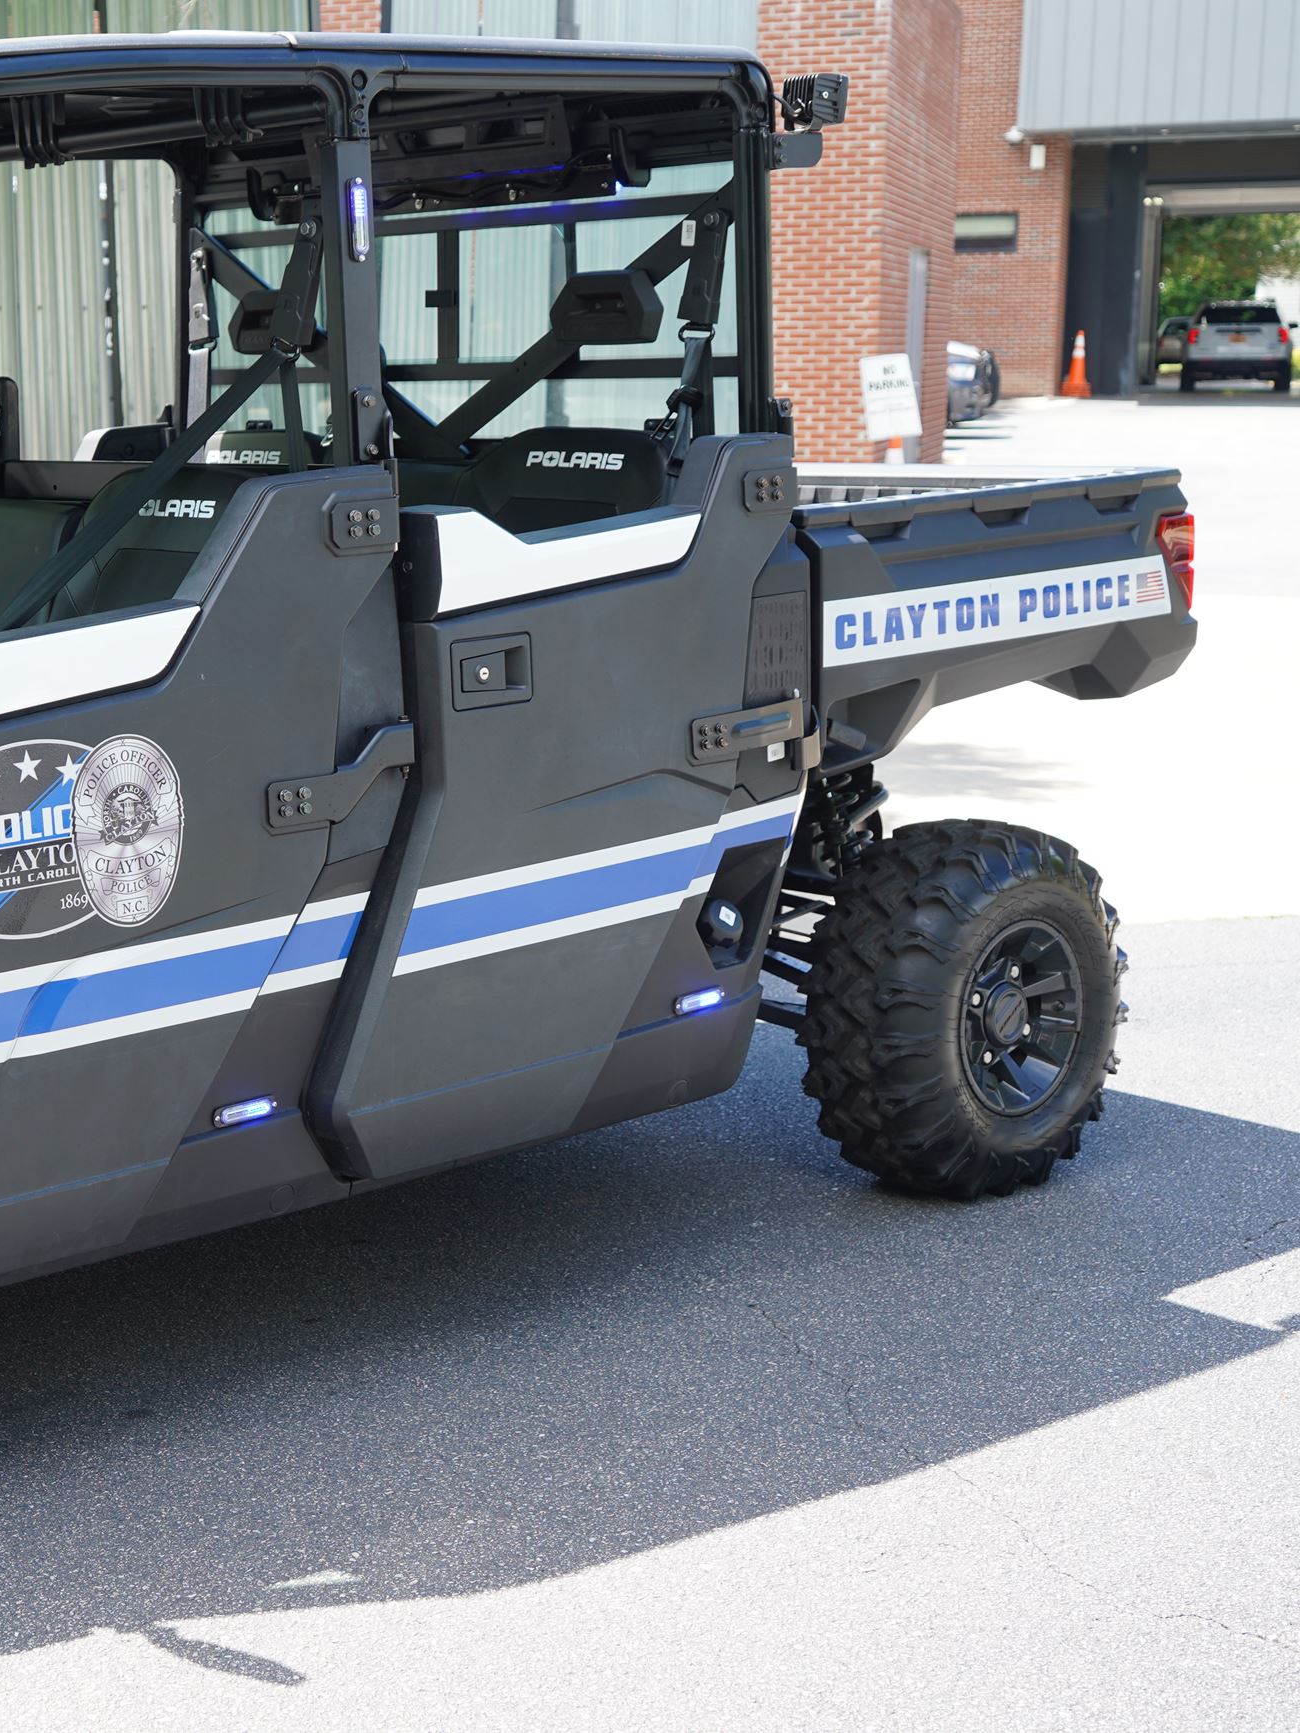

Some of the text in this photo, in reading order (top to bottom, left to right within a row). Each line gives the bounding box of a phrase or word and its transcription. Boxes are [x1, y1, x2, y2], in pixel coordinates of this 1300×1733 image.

[205, 449, 281, 464] POLARIS
[526, 450, 625, 471] POLARIS
[138, 498, 216, 519] OLARIS
[835, 574, 1130, 650] CLAYTON POLICE
[84, 749, 167, 799] POLICE OFFICER
[105, 811, 156, 841] CLAYTON
[95, 845, 167, 874] CLAYTON
[27, 866, 79, 882] CAROLI
[111, 874, 153, 893] POLICE
[60, 891, 88, 909] 1869
[122, 900, 146, 914] N.C.
